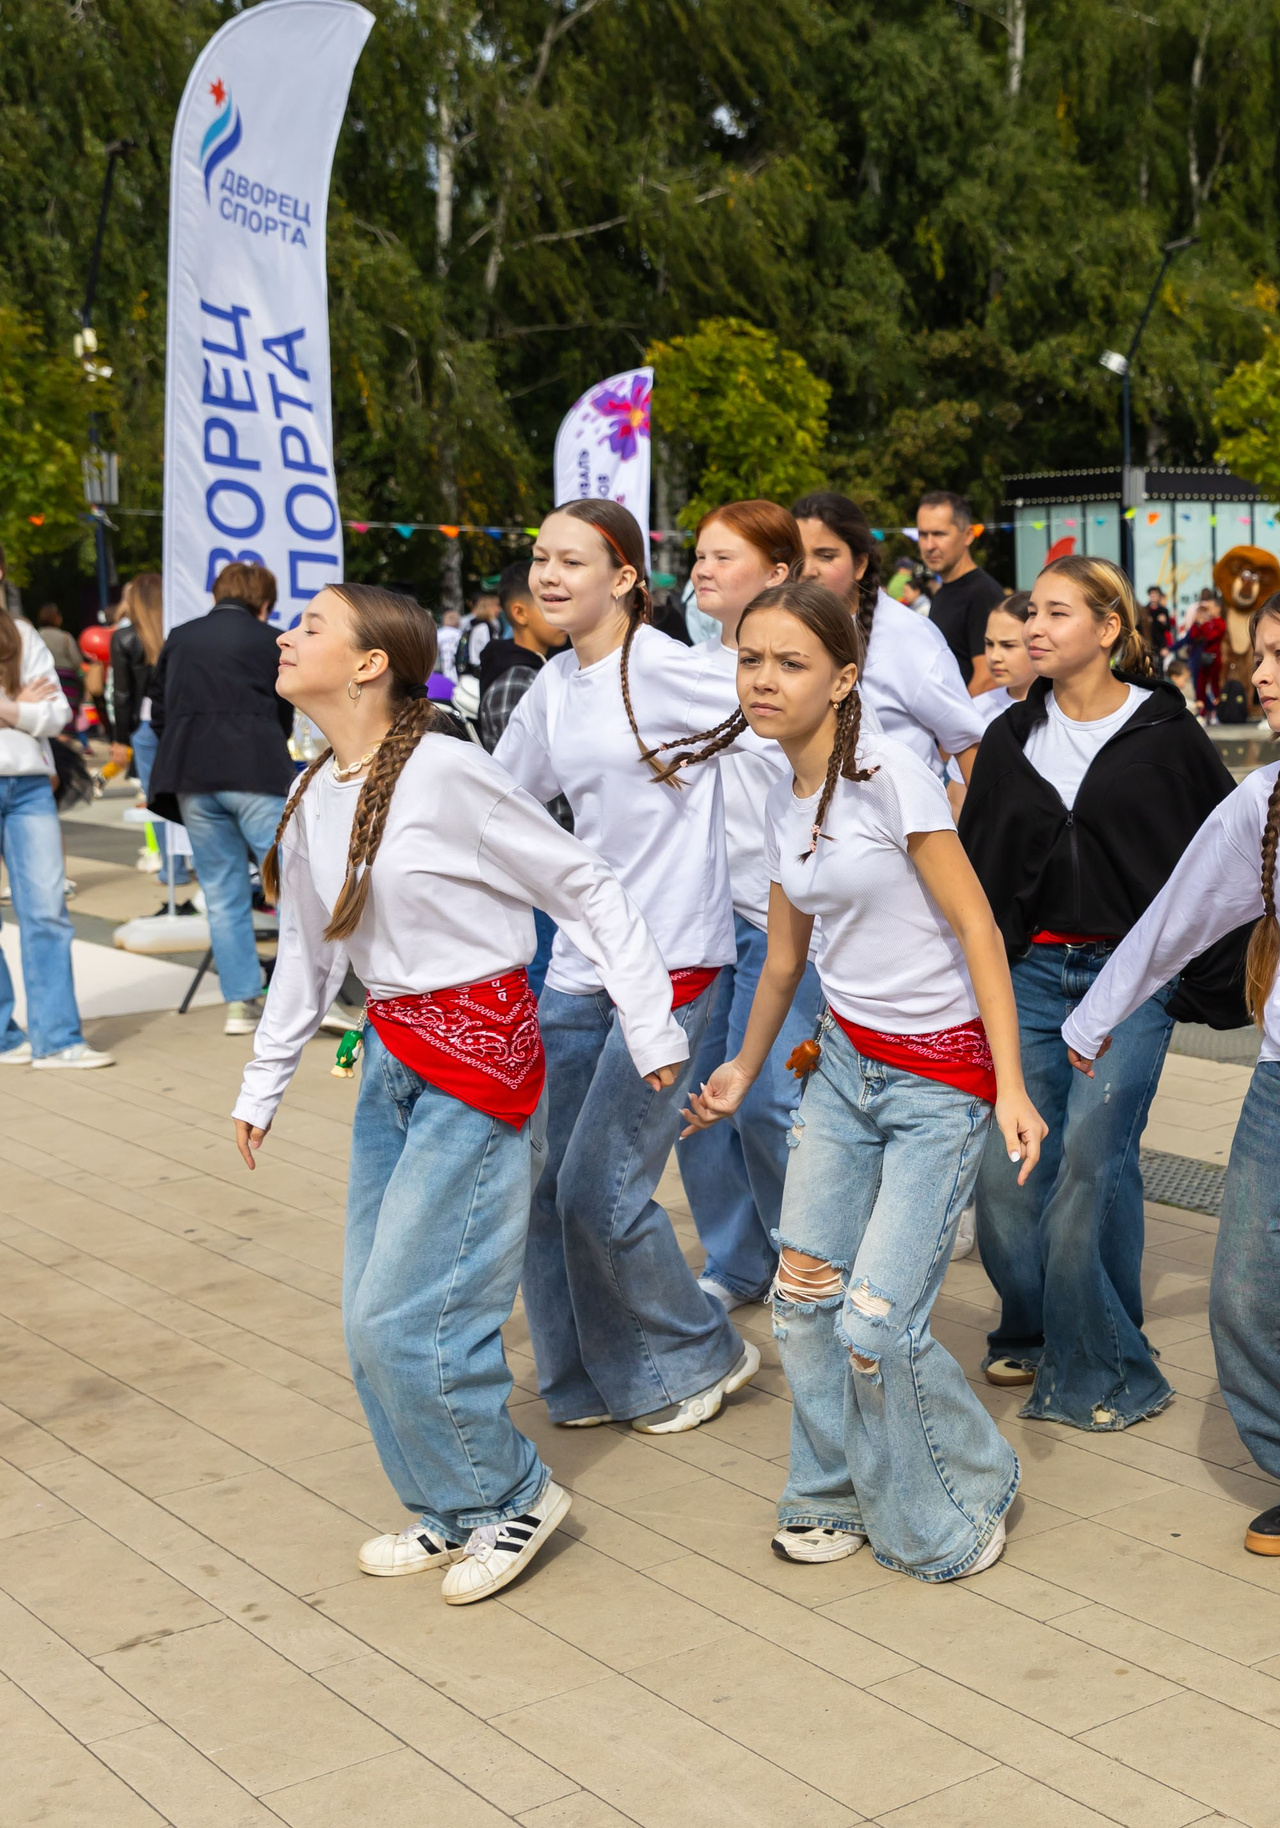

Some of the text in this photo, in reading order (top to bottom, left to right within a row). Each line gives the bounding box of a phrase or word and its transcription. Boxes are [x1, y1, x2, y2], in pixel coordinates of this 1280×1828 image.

[220, 167, 311, 229] ДВОРЕЦ
[220, 196, 308, 249] СПОРТА
[200, 298, 281, 620] ВОРЕЦ
[262, 327, 340, 630] ПОРТА
